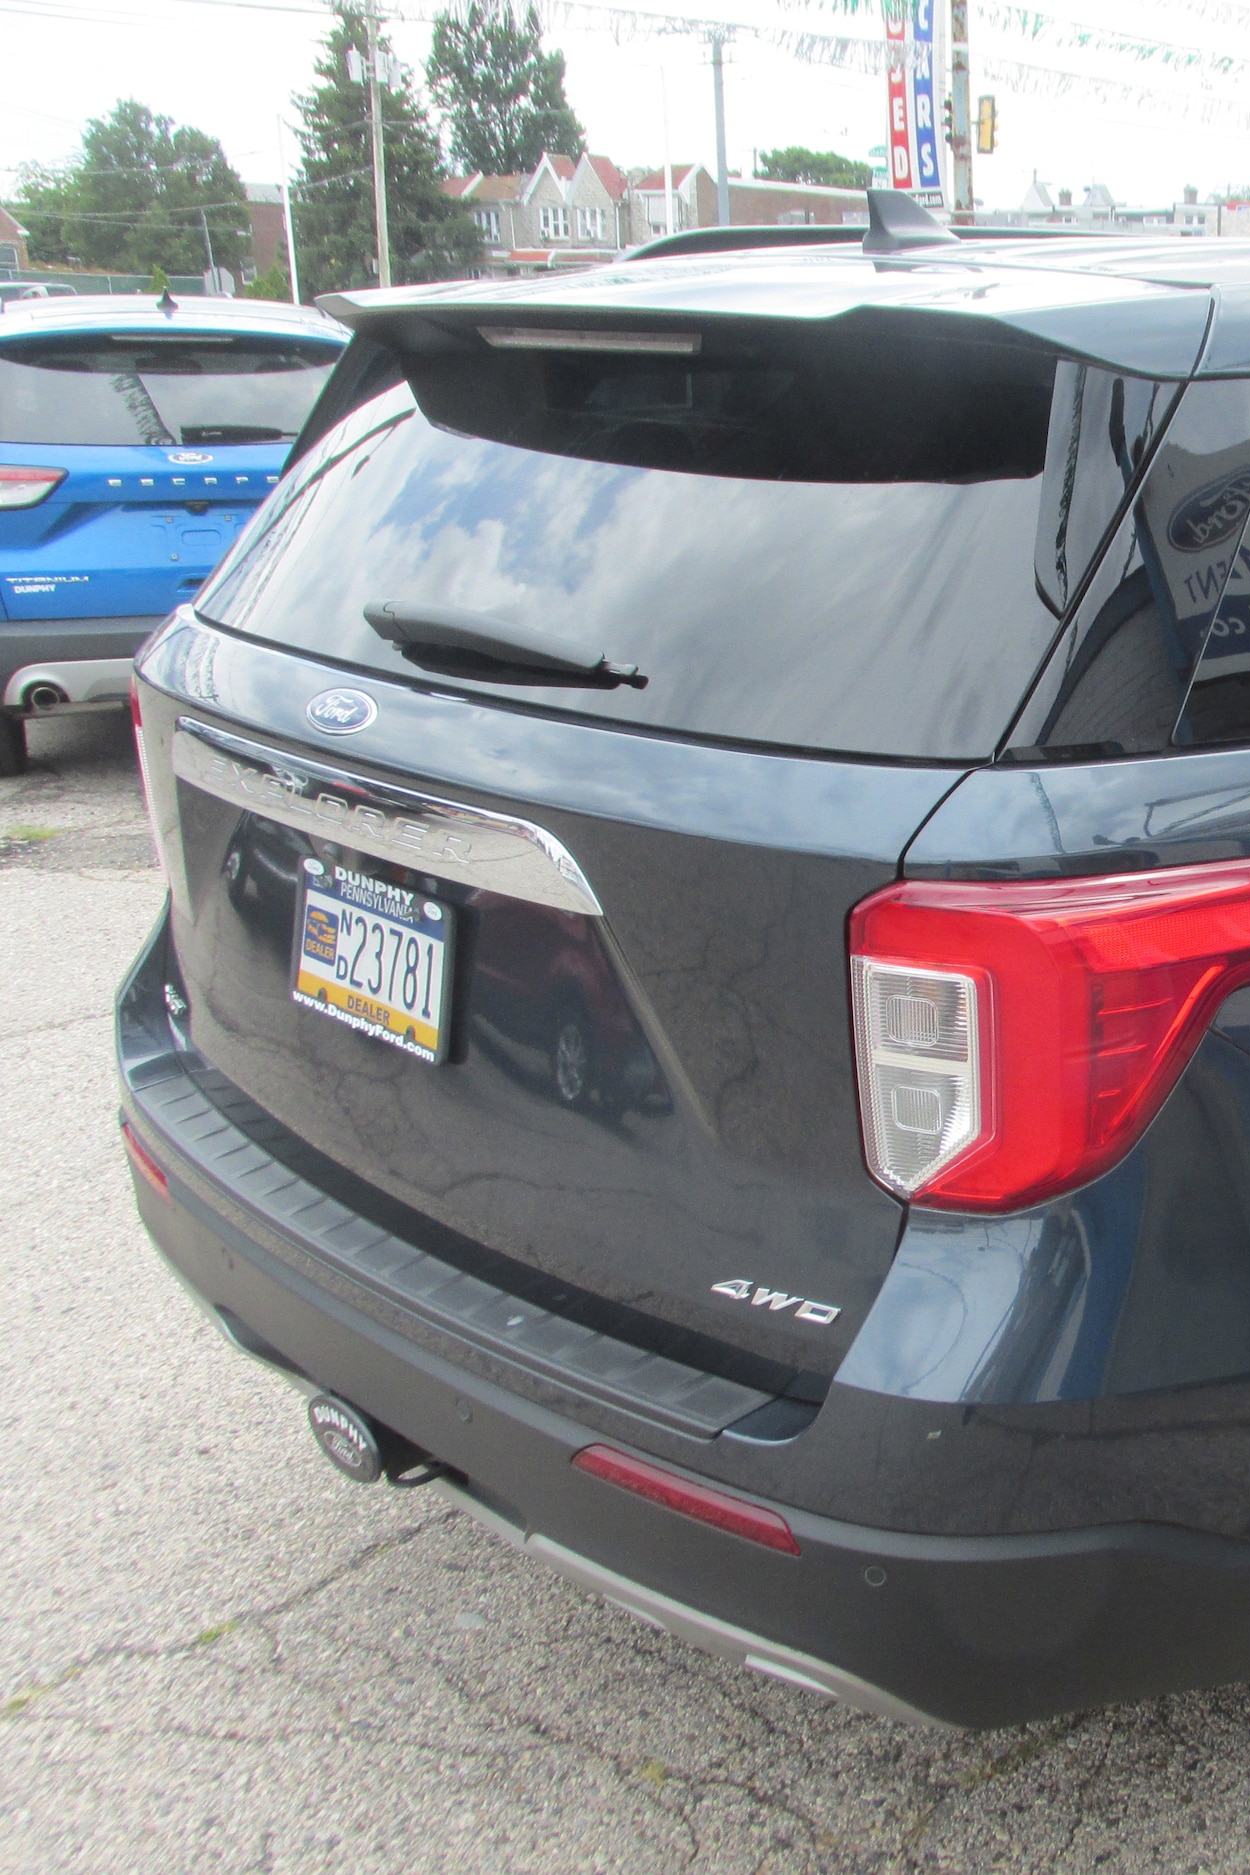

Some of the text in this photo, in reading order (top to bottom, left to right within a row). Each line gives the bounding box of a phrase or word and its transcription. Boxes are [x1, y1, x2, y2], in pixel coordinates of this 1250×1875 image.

[5, 575, 90, 584] TITANIUM
[14, 583, 56, 595] DUNPHY
[205, 758, 473, 864] EXPLORER
[334, 865, 415, 907] DUNPHY
[340, 881, 414, 924] PENNSYLVANIA
[306, 939, 334, 960] DEALER
[292, 990, 435, 1062] www.DunphyFord.com
[347, 995, 390, 1026] DEALER
[710, 1278, 842, 1325] 4WD
[313, 1404, 368, 1452] DUNPHY
